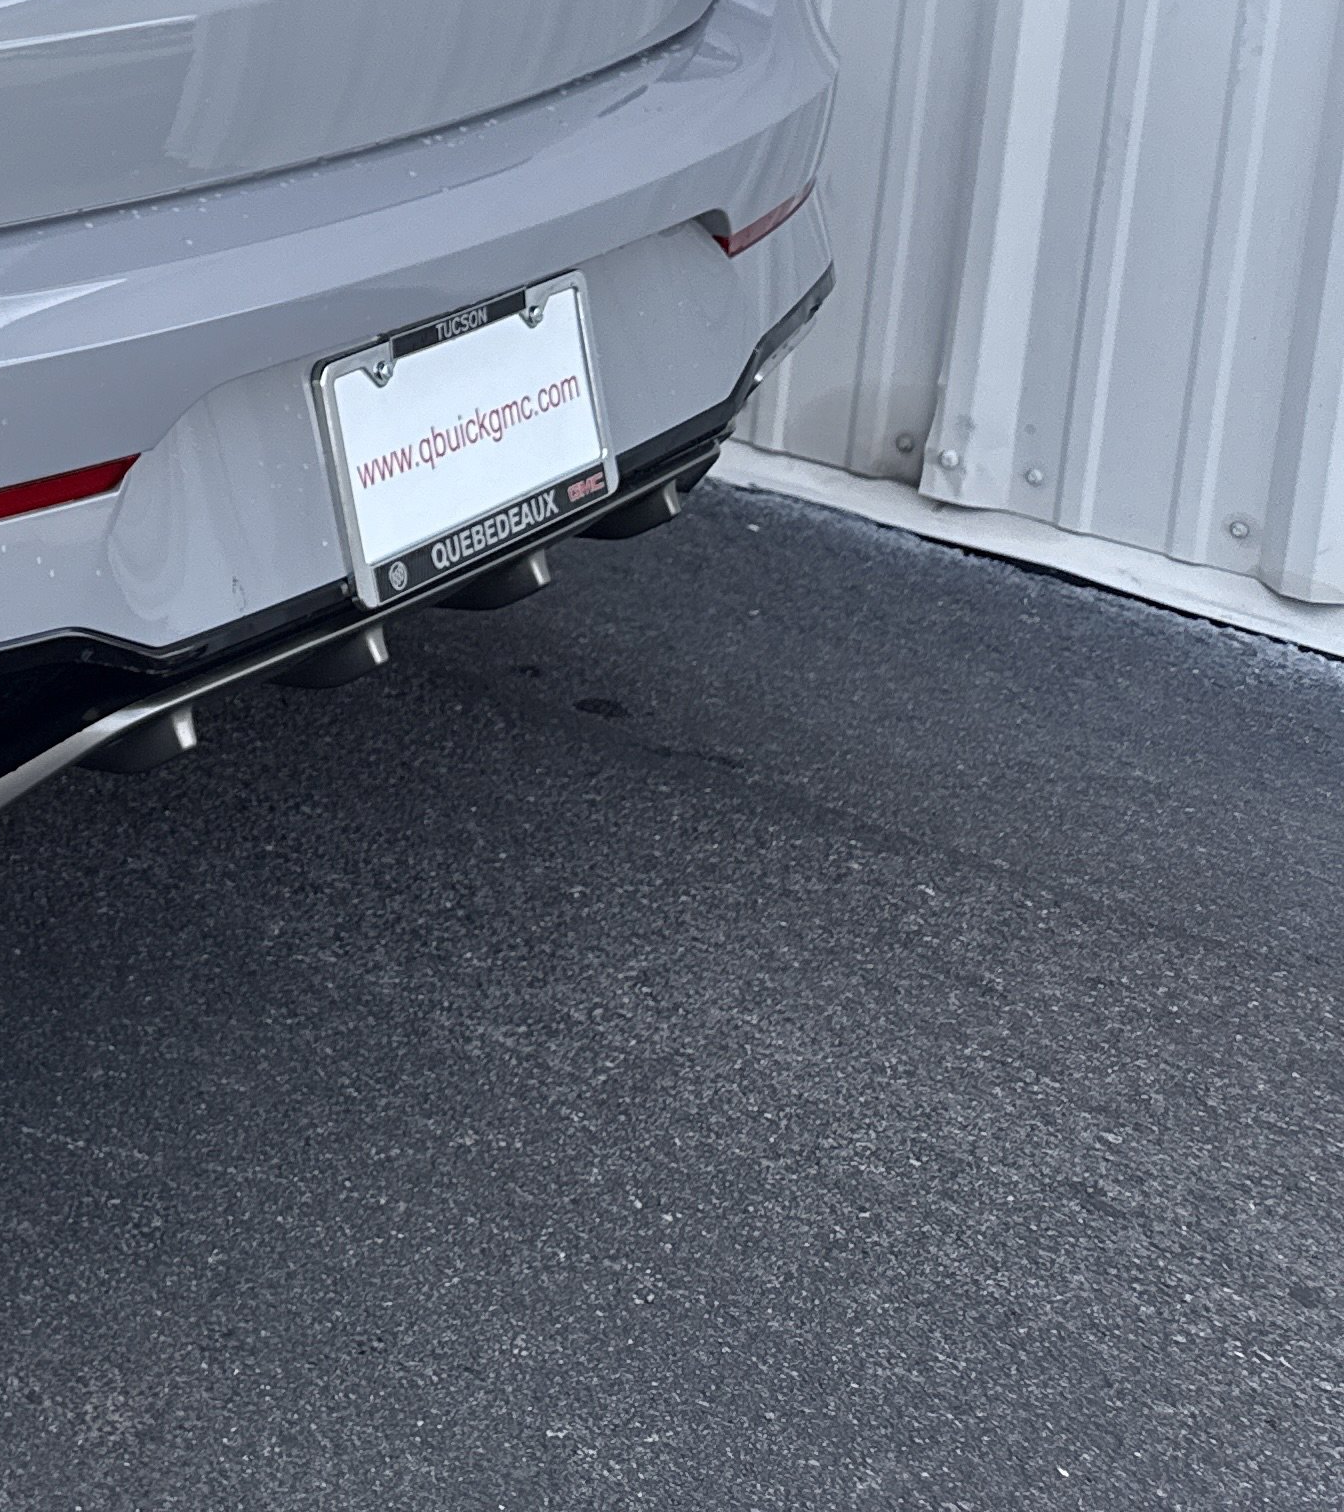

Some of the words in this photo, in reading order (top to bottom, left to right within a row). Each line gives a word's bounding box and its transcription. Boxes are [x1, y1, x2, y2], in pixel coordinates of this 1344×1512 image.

[435, 306, 488, 341] TUCSON
[357, 375, 580, 489] www.qbuickgmc.com
[431, 489, 559, 569] QUEBEDEAUX
[567, 471, 605, 502] GMC
